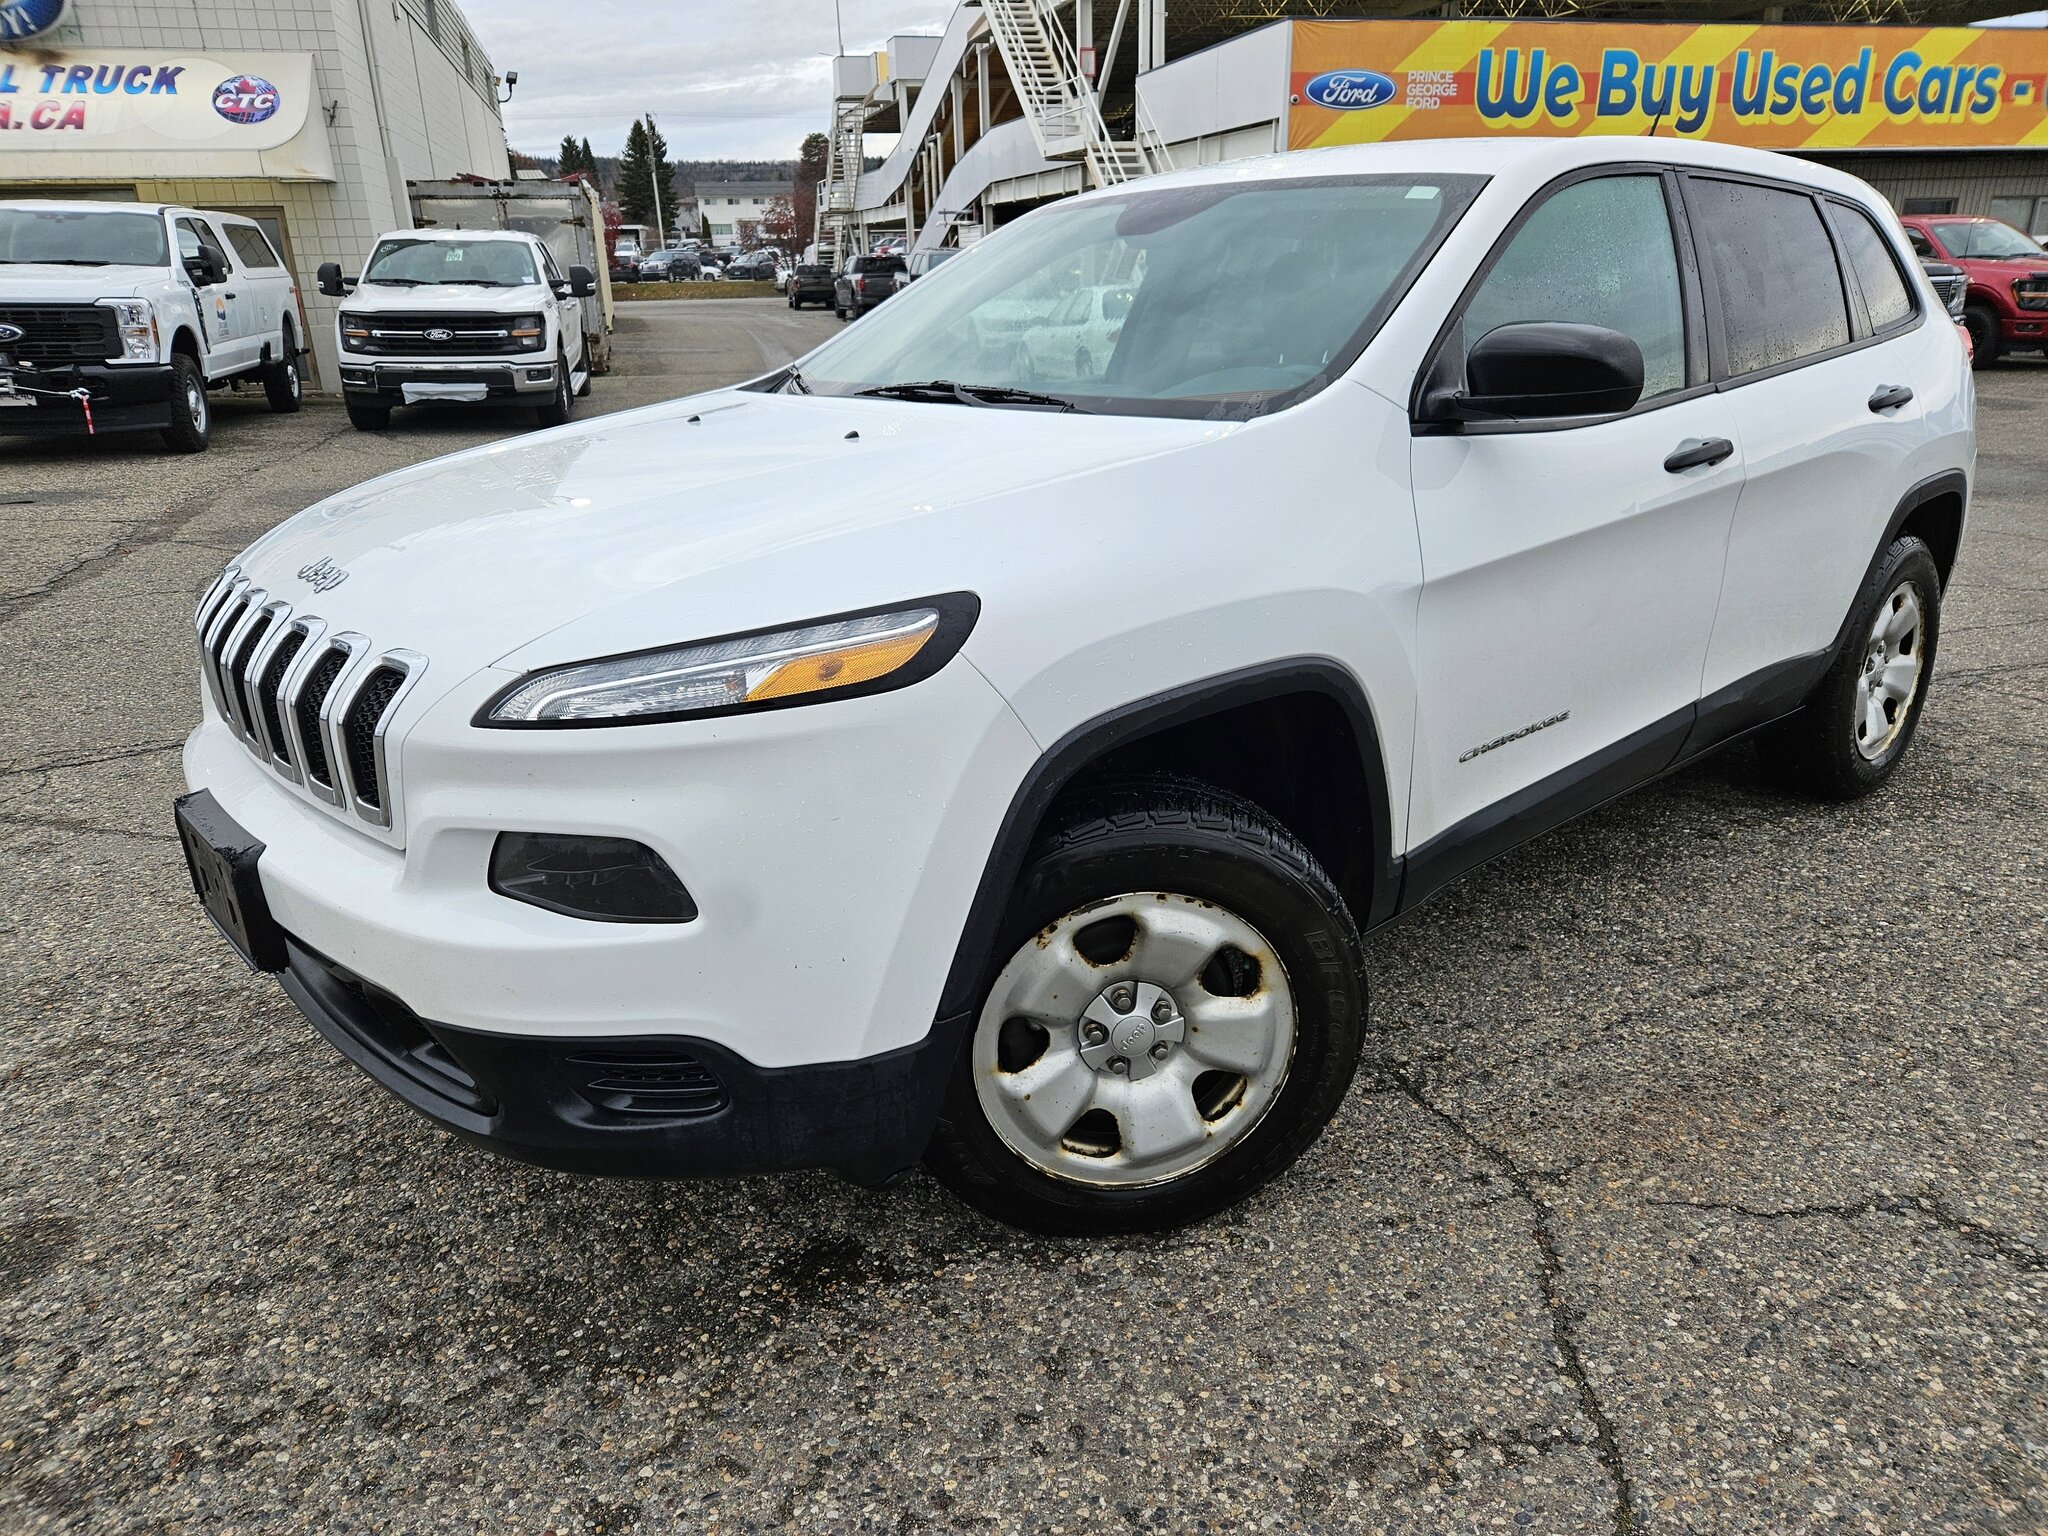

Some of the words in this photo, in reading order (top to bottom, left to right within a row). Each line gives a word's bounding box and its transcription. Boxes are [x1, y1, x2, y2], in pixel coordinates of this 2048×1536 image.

[38, 64, 186, 95] TRUCK
[1322, 75, 1379, 104] Ford
[1406, 84, 1457, 96] GEORGE
[1407, 71, 1454, 83] PRINCE
[1476, 48, 1580, 119] We
[1596, 49, 1716, 133] Buy
[1732, 47, 1873, 116] Used
[1883, 50, 2002, 115] Cars
[215, 93, 274, 109] CTC
[1405, 97, 1440, 110] FORD
[297, 556, 349, 594] Jeep
[1459, 710, 1571, 763] CHEROKEE
[1120, 1023, 1147, 1050] Jeep
